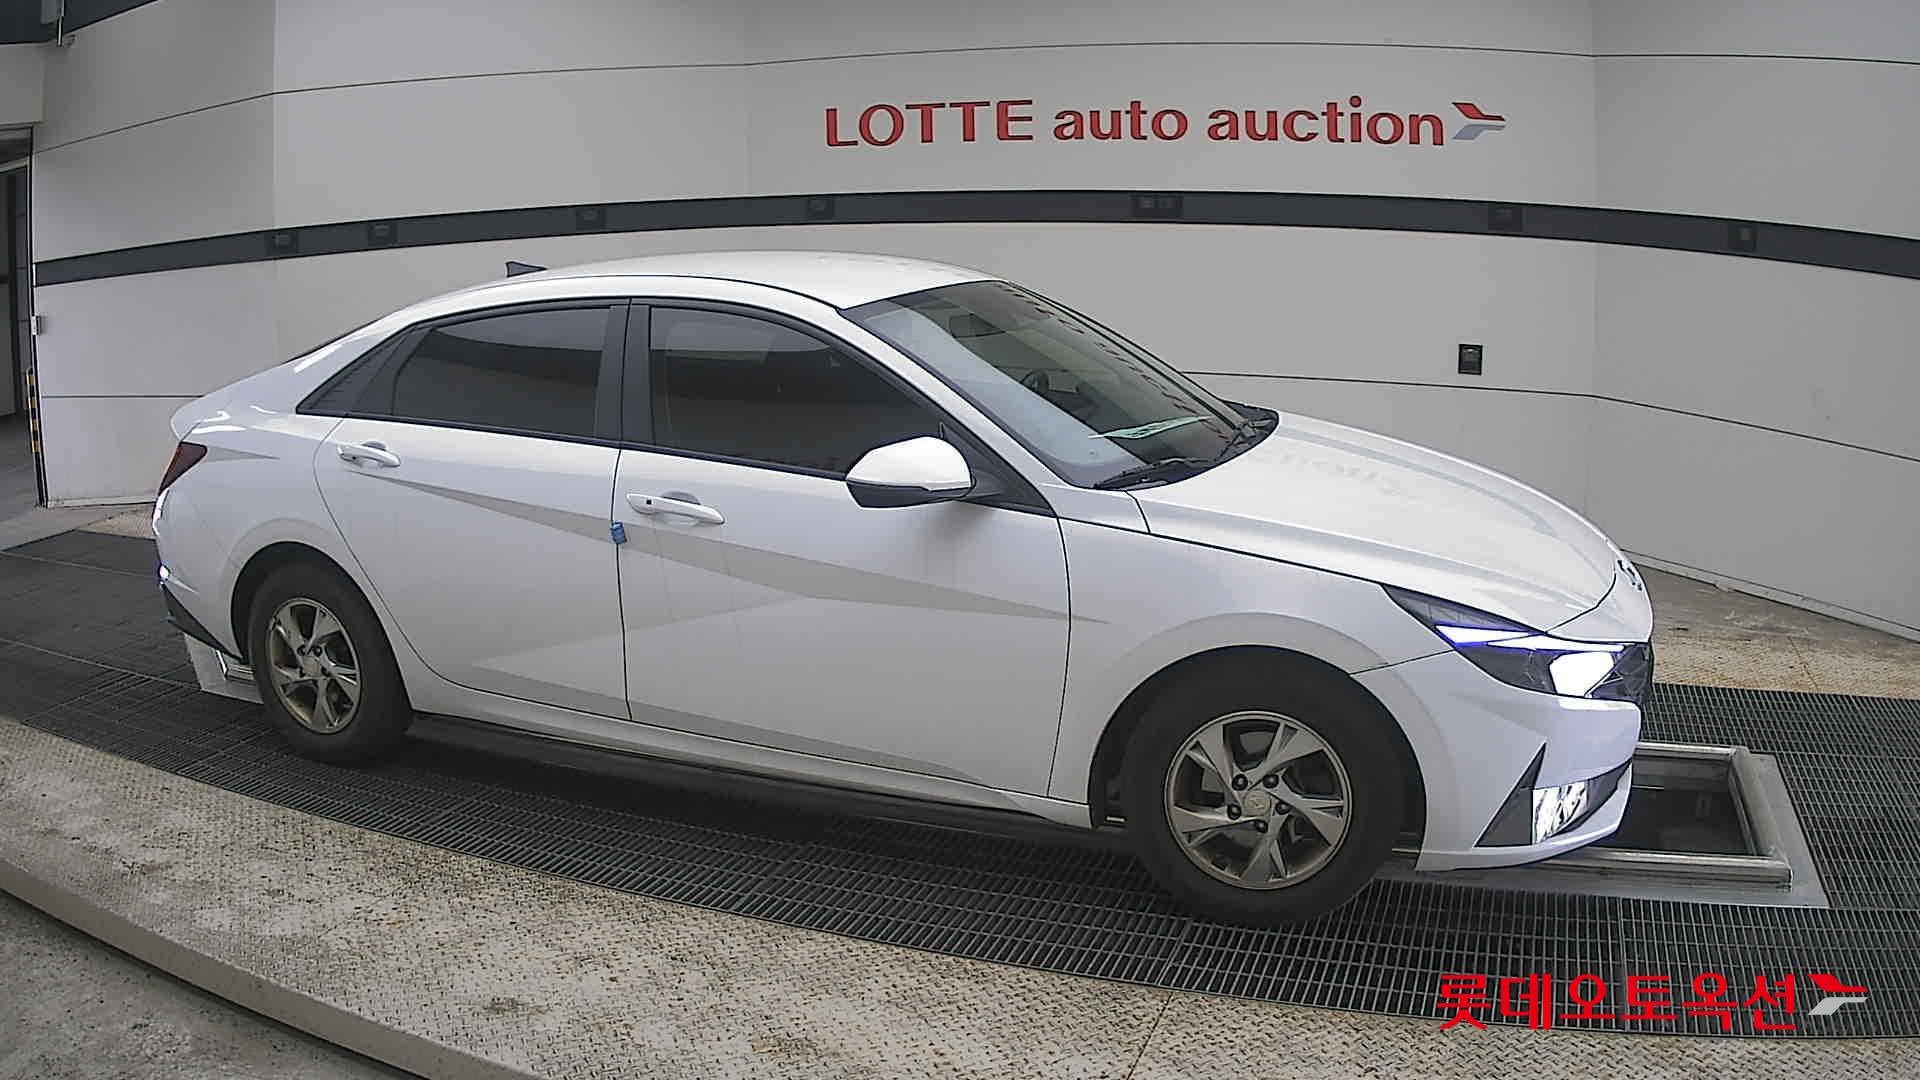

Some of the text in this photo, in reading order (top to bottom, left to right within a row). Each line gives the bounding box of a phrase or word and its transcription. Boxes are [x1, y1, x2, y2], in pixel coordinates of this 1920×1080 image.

[825, 96, 1445, 147] LOTTE auto auction
